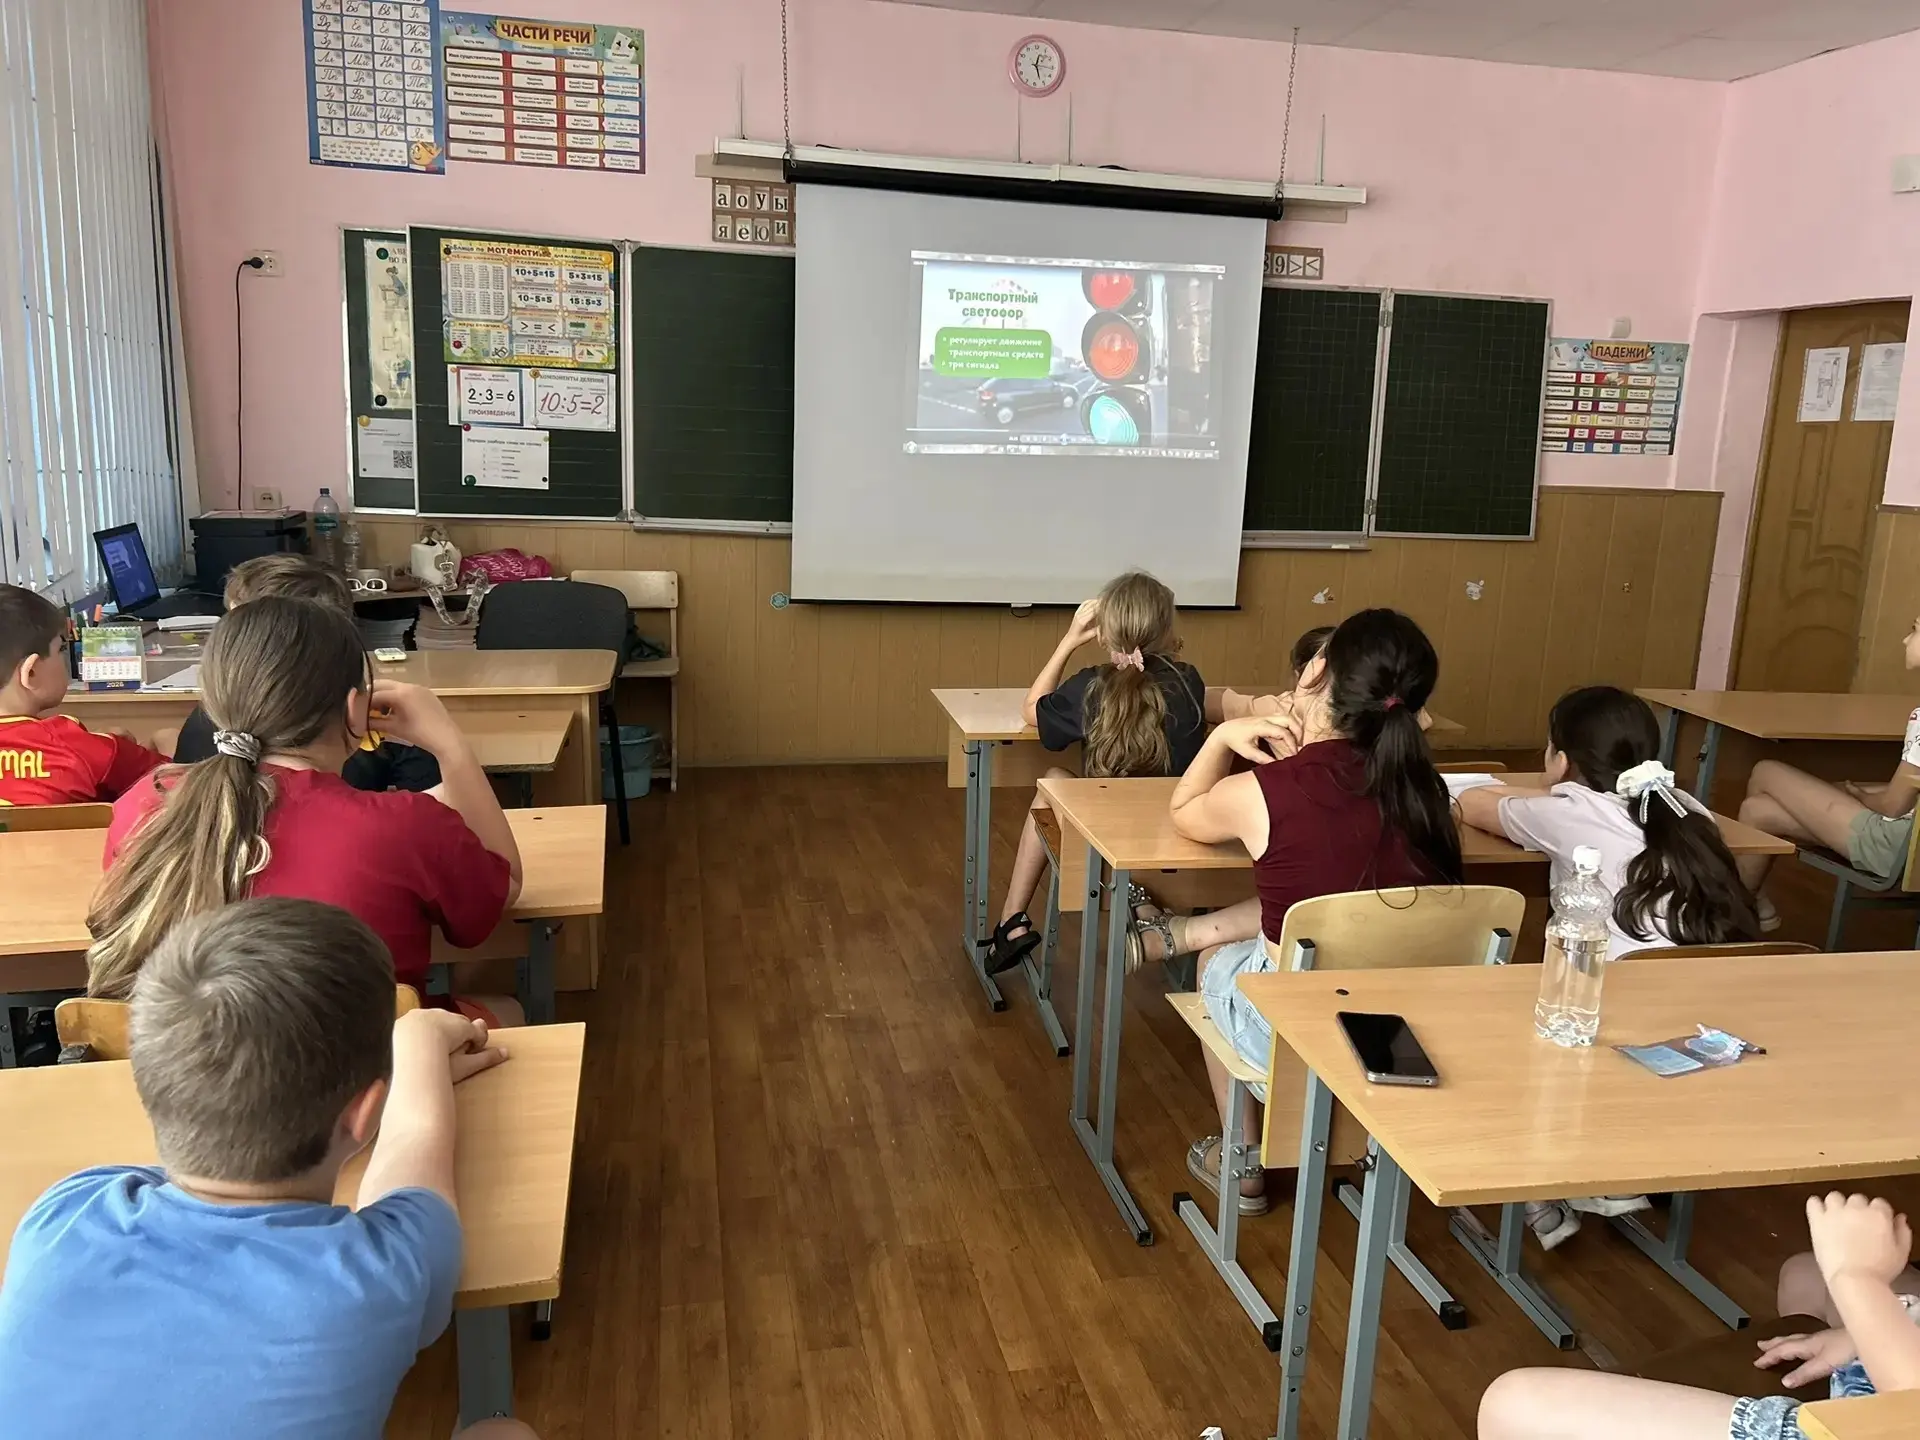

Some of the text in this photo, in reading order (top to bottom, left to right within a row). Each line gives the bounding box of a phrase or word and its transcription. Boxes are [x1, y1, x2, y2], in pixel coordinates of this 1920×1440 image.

[501, 24, 591, 44] ЧАСТИ РЕЧИ
[948, 288, 1038, 304] Транспортный
[962, 307, 1023, 320] светофор
[949, 337, 997, 347] регулирует
[949, 350, 1009, 359] транспортных
[1595, 346, 1644, 358] ПАДЕЖИ
[948, 361, 964, 371] три
[0, 750, 50, 779] MAL
